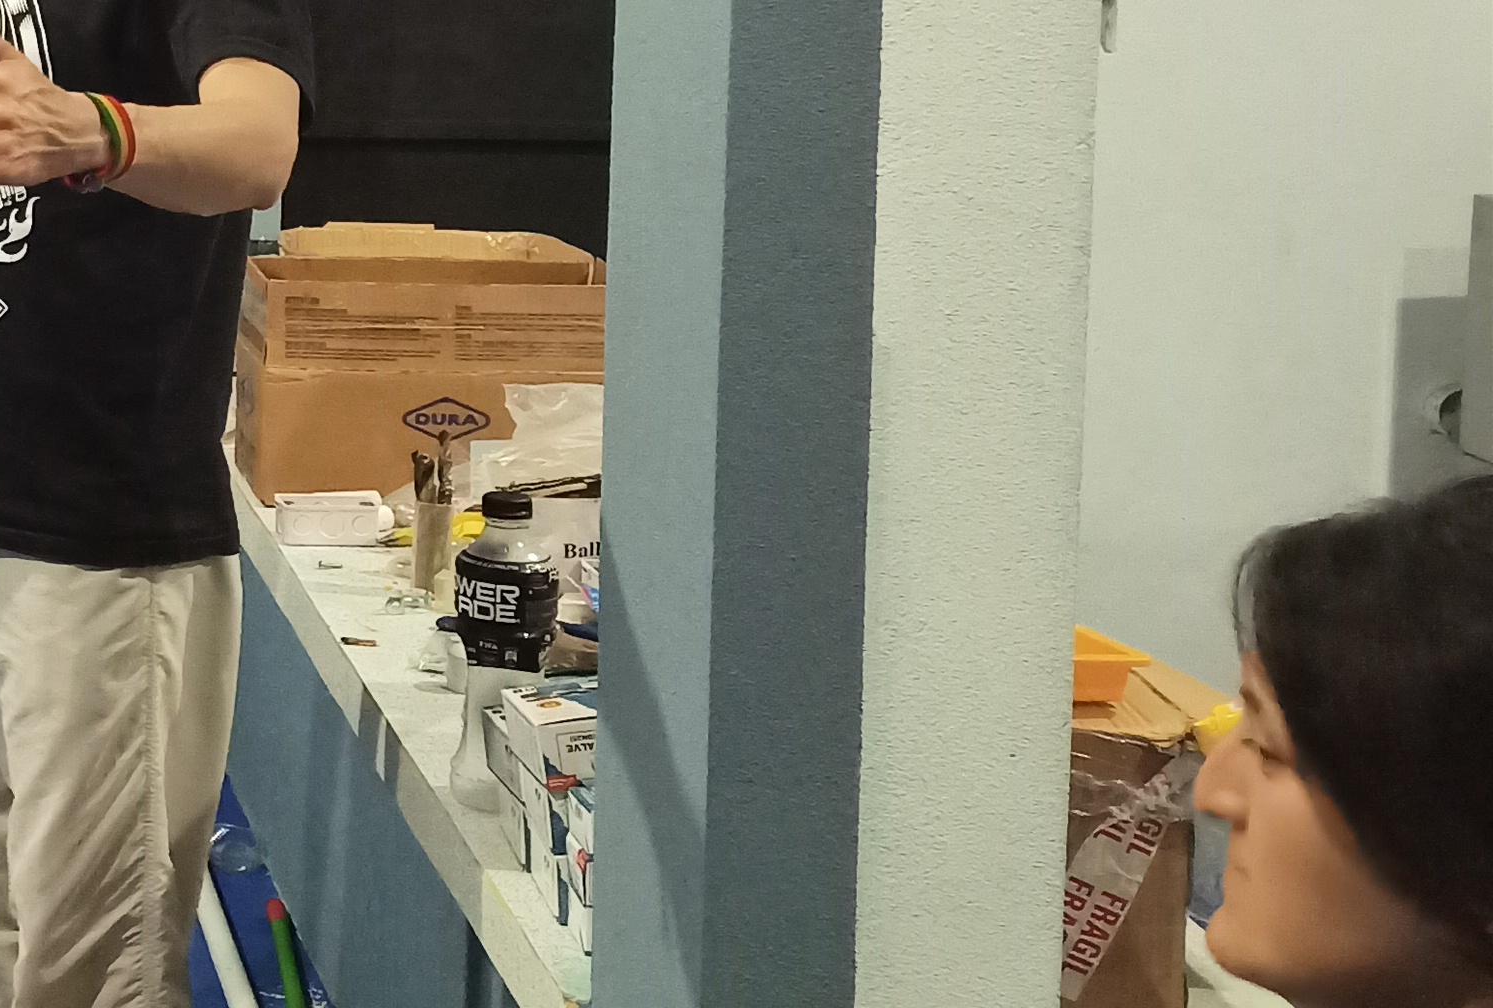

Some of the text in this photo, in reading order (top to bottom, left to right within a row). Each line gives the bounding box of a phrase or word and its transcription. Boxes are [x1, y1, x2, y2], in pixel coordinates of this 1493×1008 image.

[415, 413, 480, 427] DURA
[564, 541, 601, 559] Ball
[458, 595, 520, 624] ADE
